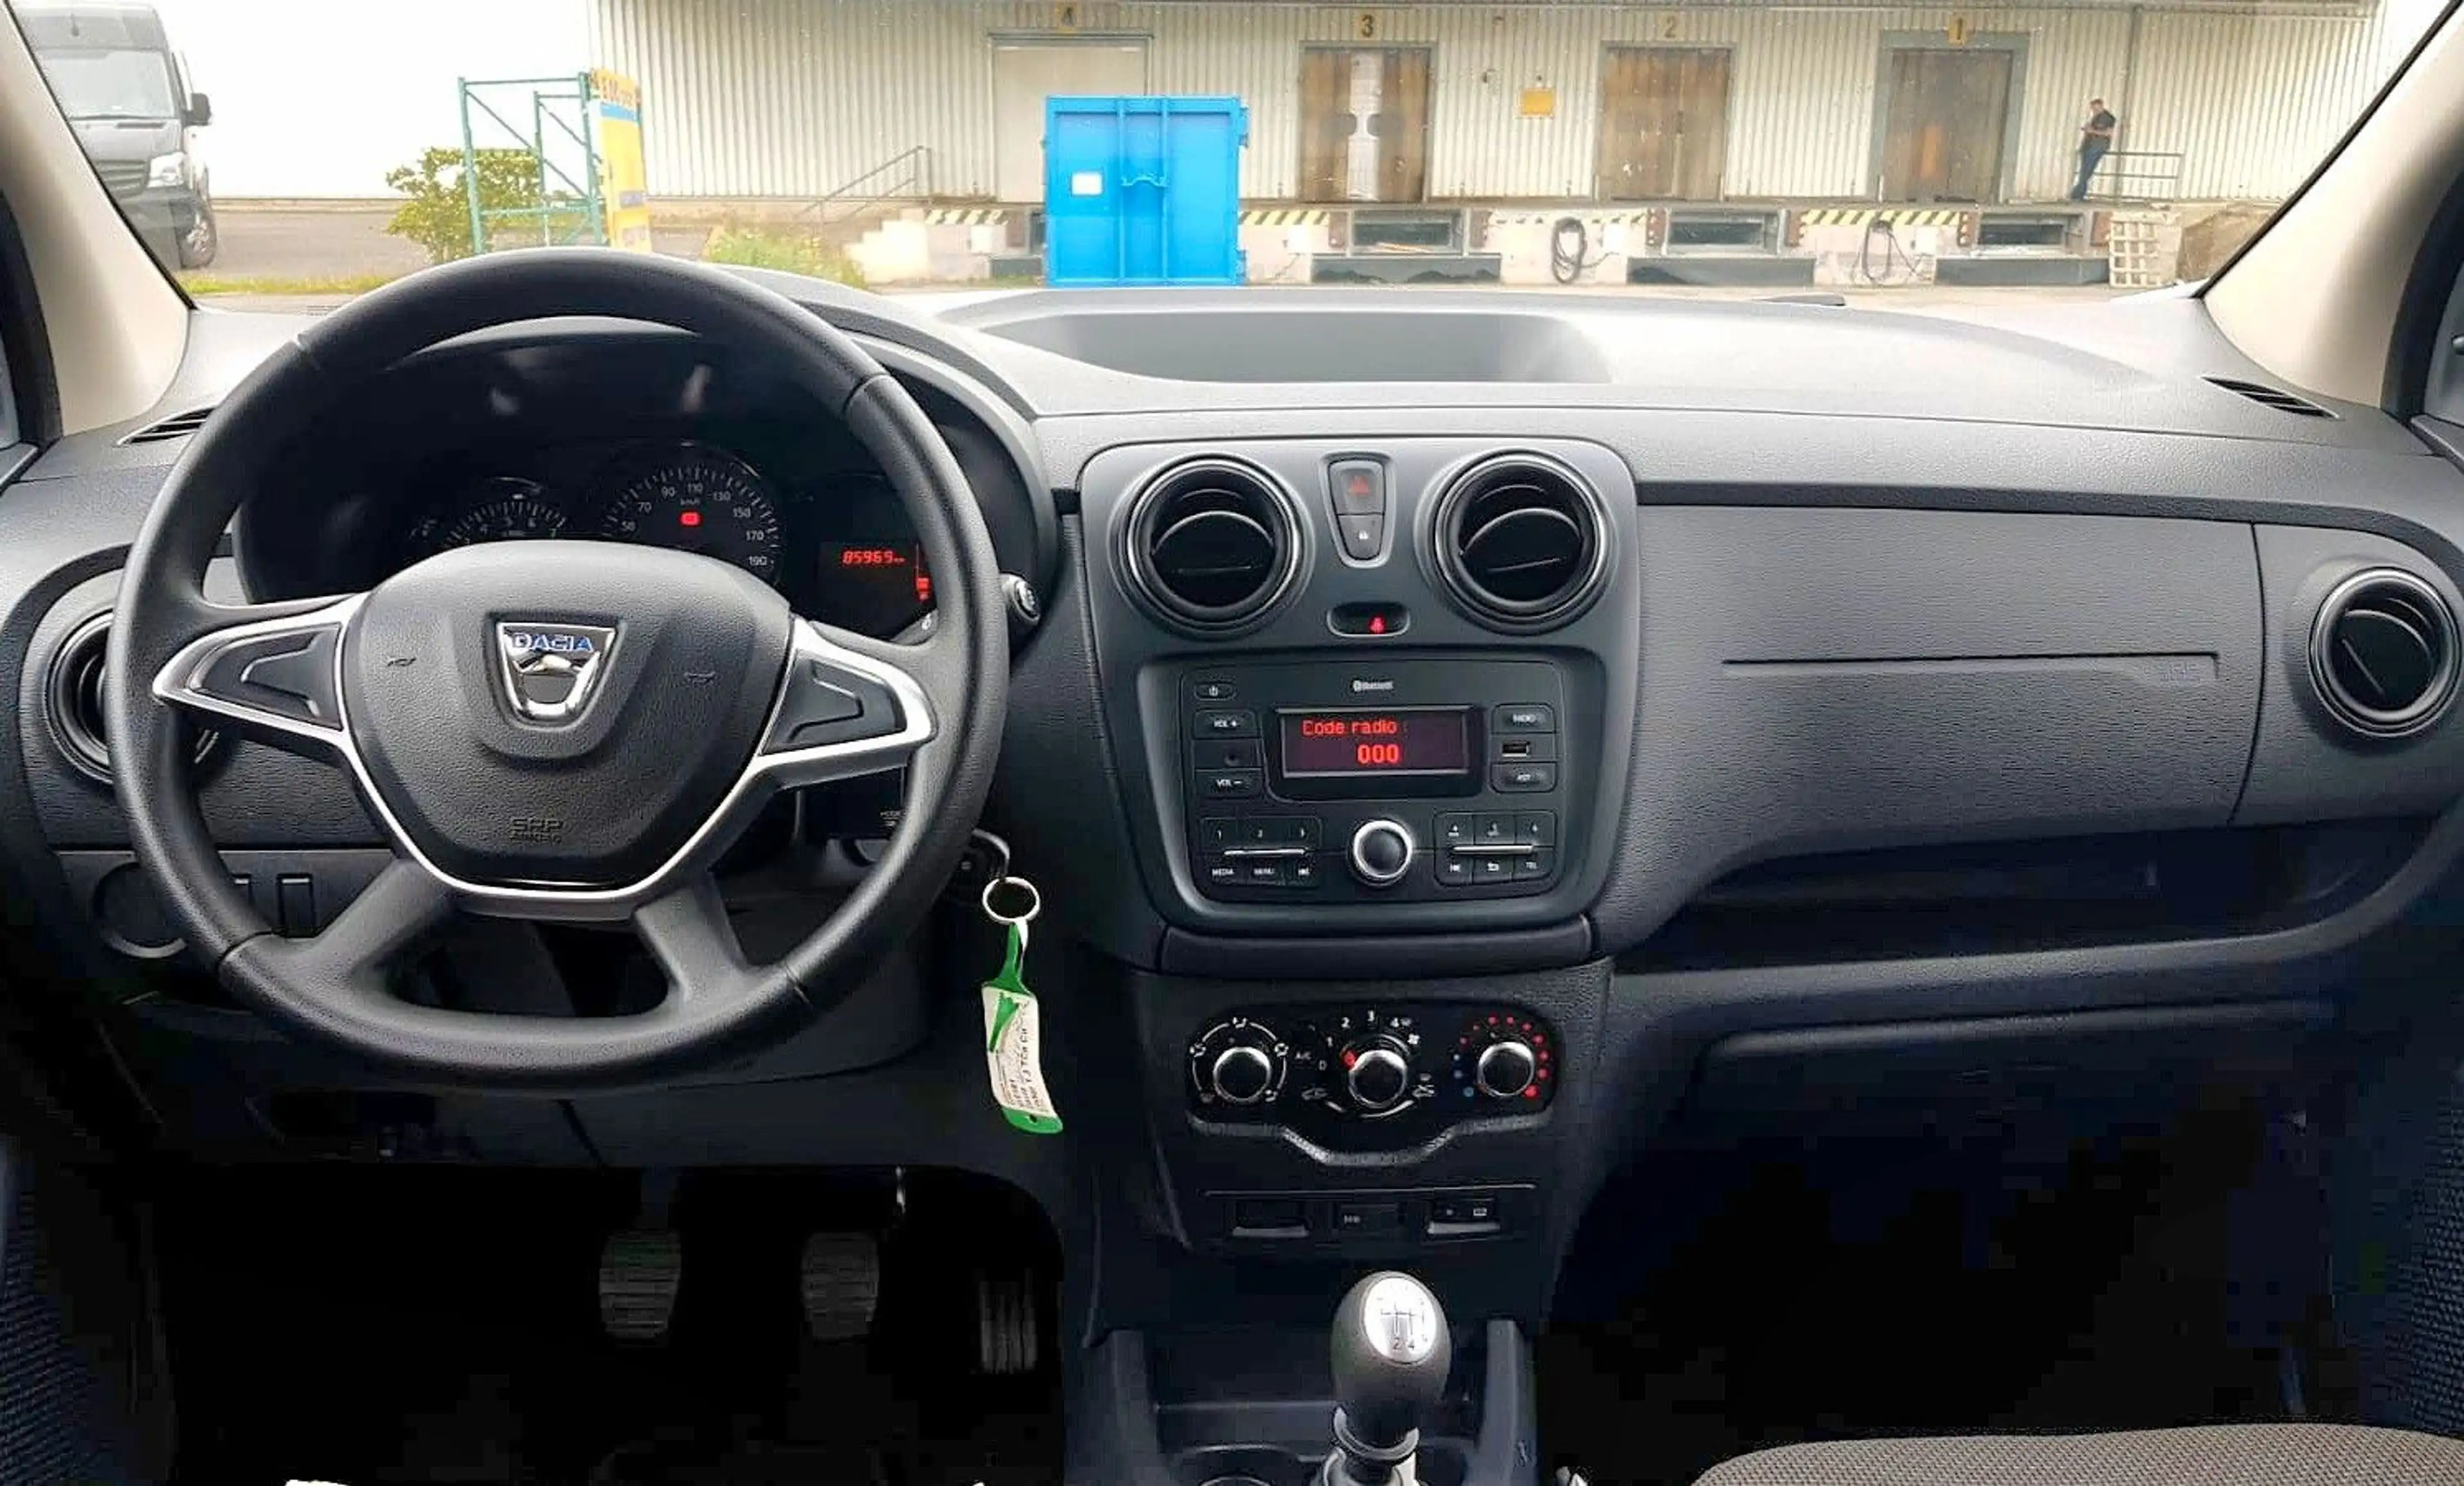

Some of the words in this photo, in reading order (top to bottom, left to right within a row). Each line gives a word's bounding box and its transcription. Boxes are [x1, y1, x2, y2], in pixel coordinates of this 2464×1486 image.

[1360, 14, 1374, 38] 3
[1664, 16, 1678, 38] 2
[661, 486, 675, 499] 90
[687, 483, 703, 494] 110
[713, 491, 731, 500] 130
[639, 502, 652, 513] 70
[733, 507, 751, 518] 150
[746, 530, 764, 541] 170
[749, 556, 767, 565] 190
[513, 632, 594, 653] DACIA
[1303, 719, 1346, 735] Code
[1351, 719, 1398, 735] radio
[1357, 744, 1400, 764] 000
[1341, 1016, 1351, 1029] 2
[1390, 1017, 1399, 1028] 4
